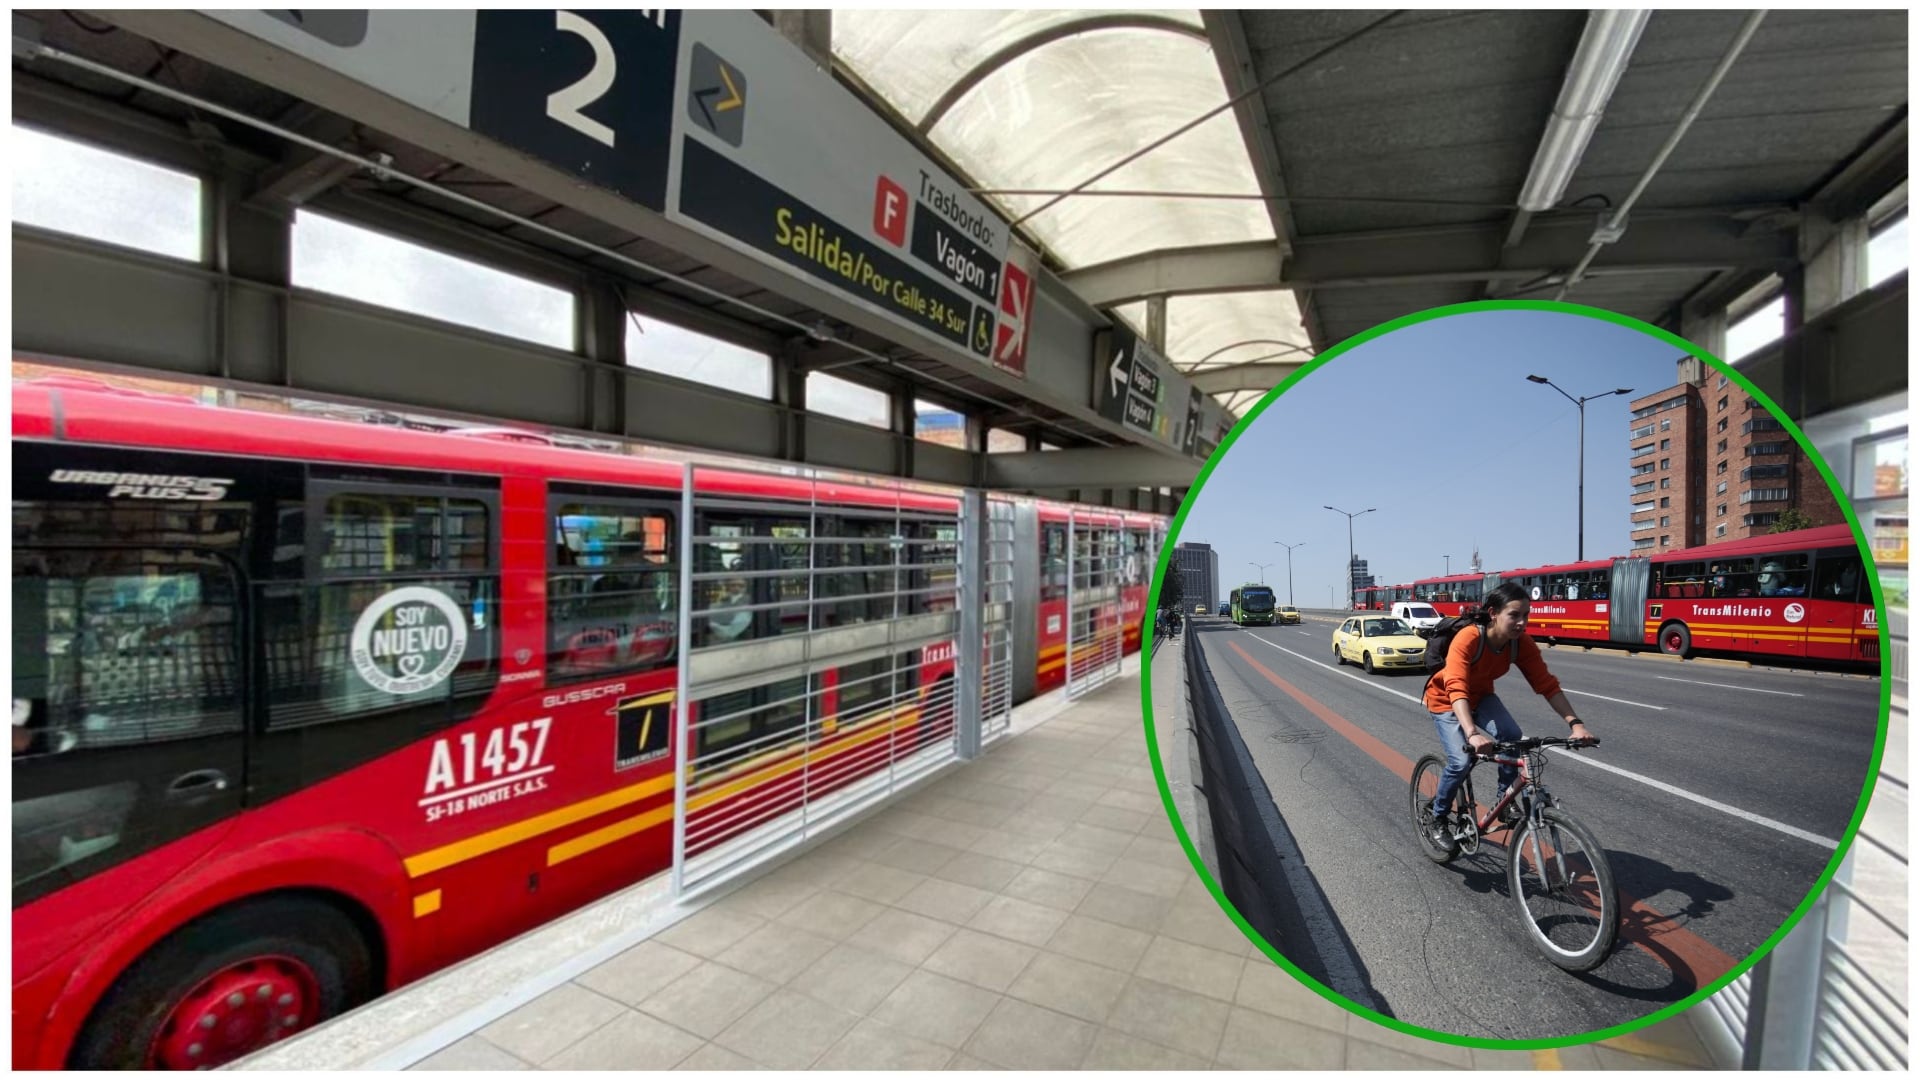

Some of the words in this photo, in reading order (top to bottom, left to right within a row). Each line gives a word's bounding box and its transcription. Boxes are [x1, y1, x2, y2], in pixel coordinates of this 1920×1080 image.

[546, 9, 617, 148] 2
[884, 191, 899, 229] F
[919, 169, 995, 247] Trasbordo:
[936, 230, 985, 290] Vagón
[989, 271, 998, 298] 1
[893, 280, 927, 316] Calle
[928, 298, 944, 324] 34
[946, 308, 967, 335] Sur
[49, 469, 197, 488] URBANUS
[107, 485, 190, 499] PLUS
[395, 606, 428, 626] SOY
[1692, 604, 1772, 617] TransMilenio
[373, 625, 449, 657] NUEVO
[424, 716, 553, 794] A1457
[426, 798, 465, 822] SI-18
[467, 785, 511, 811] NORTE
[513, 775, 549, 798] S.A.S.
